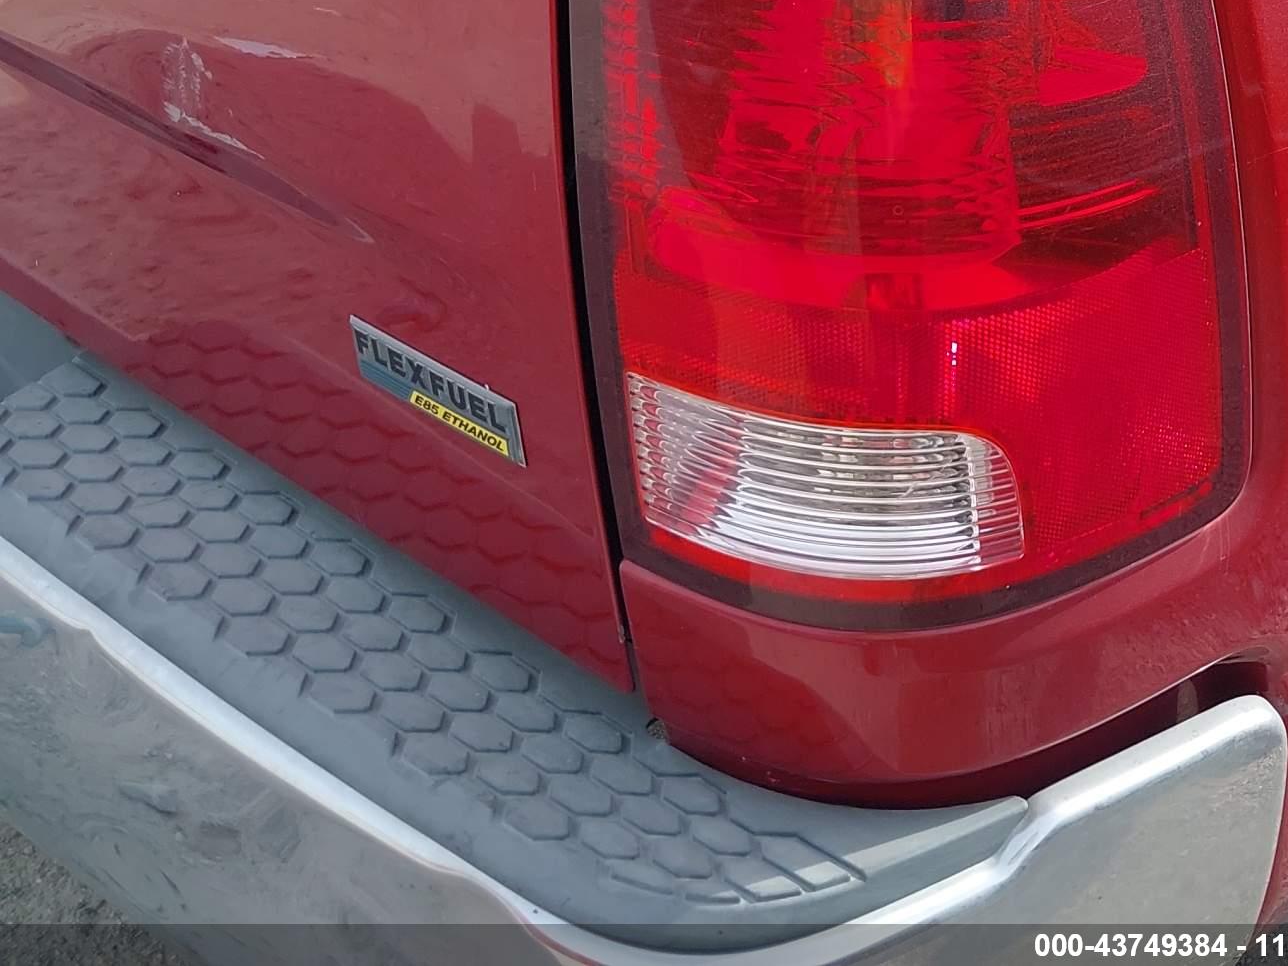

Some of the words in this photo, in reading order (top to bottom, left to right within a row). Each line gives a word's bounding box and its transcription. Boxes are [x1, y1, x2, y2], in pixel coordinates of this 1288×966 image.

[354, 328, 507, 433] FLEXFUEL
[414, 393, 439, 416] E85
[442, 410, 506, 452] ETHANOL
